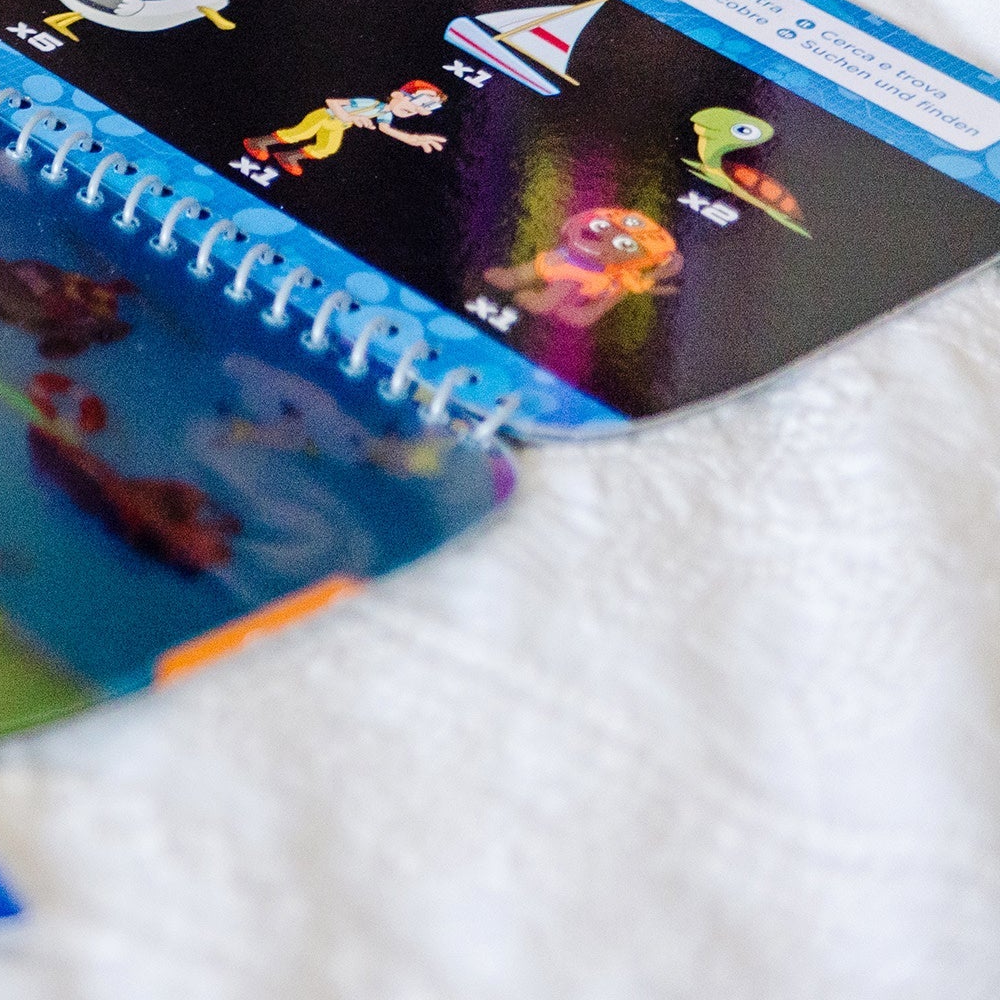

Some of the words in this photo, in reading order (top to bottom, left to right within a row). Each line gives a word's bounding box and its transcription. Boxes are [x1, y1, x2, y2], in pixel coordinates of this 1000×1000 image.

[442, 59, 493, 89] x1
[821, 30, 876, 63] Cerca
[879, 61, 892, 71] e
[896, 69, 948, 100] trova
[800, 39, 871, 79] Suchen
[874, 78, 915, 101] und
[916, 99, 980, 136] finden
[228, 155, 280, 187] x1
[676, 190, 740, 227] x2
